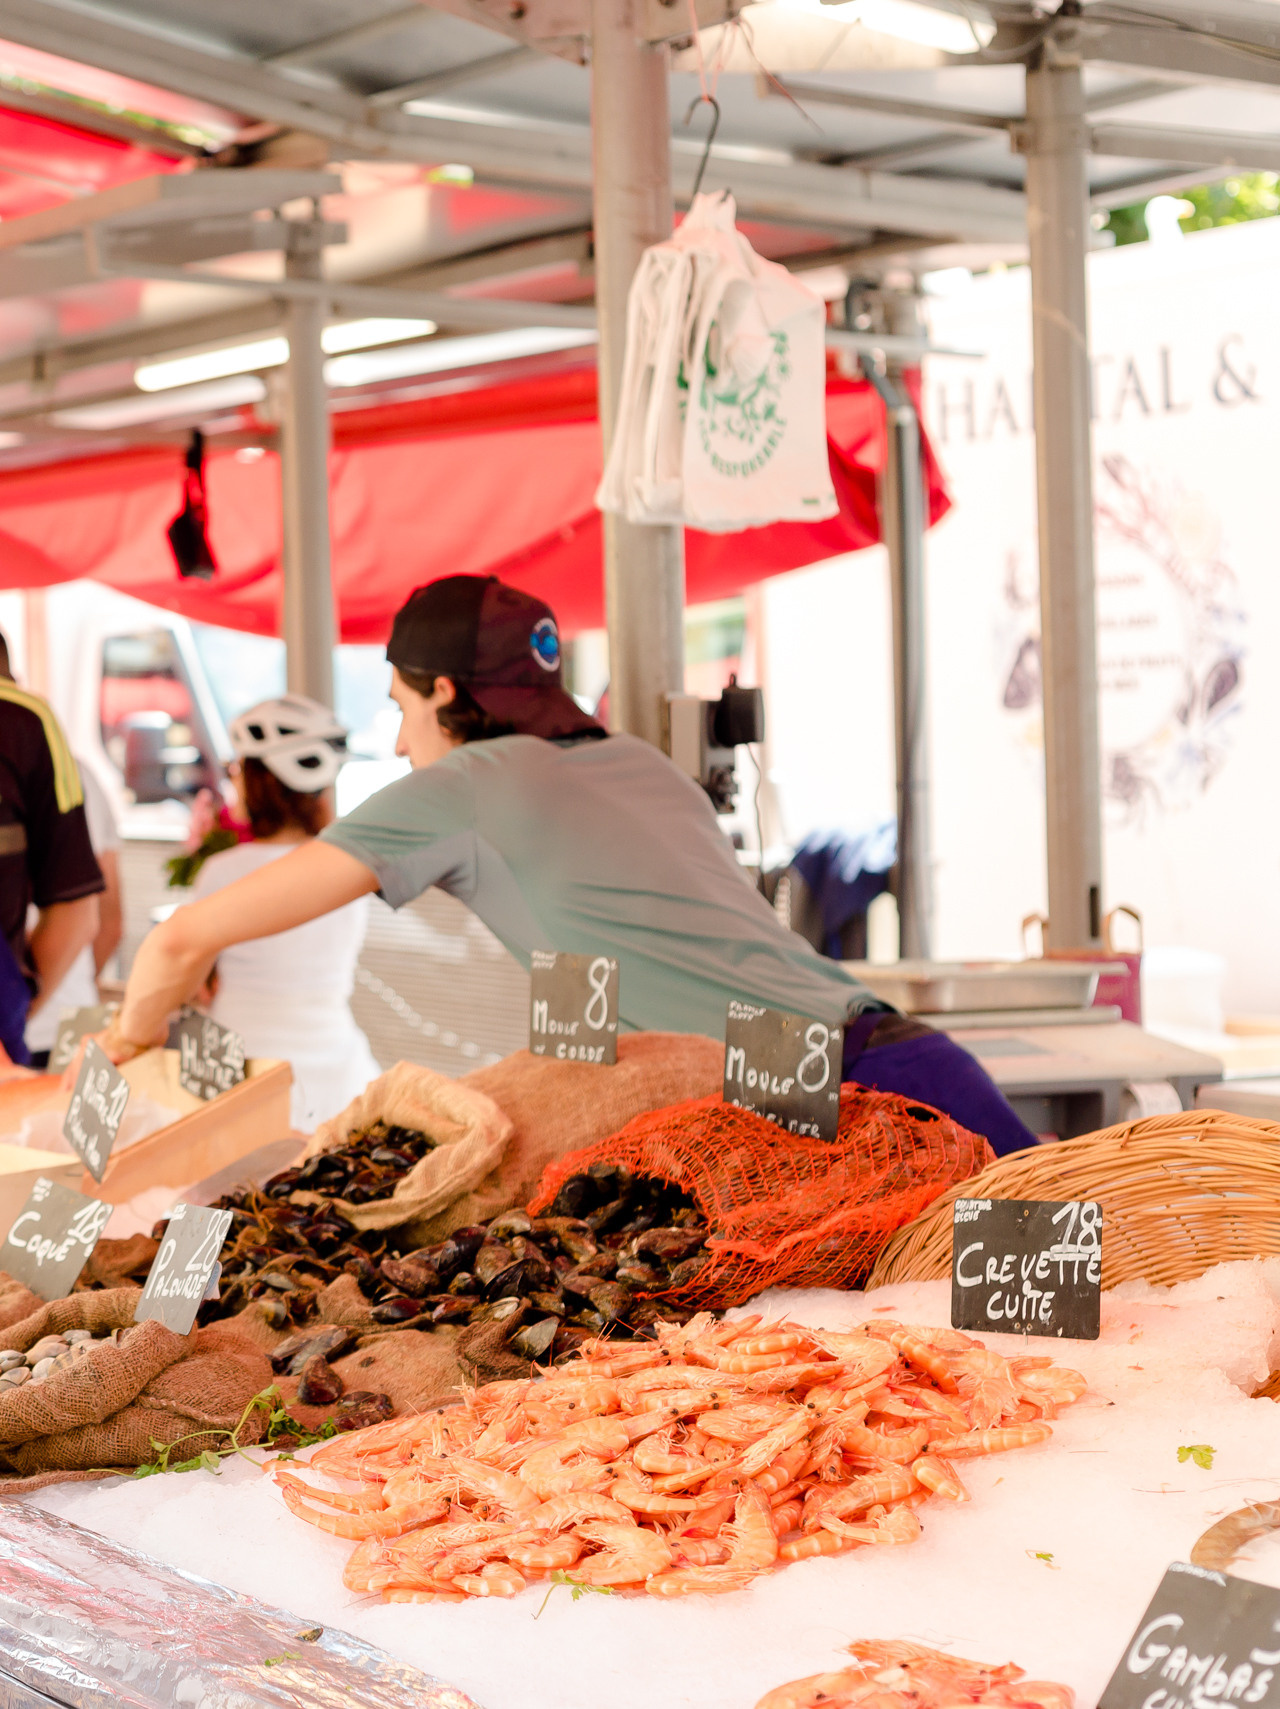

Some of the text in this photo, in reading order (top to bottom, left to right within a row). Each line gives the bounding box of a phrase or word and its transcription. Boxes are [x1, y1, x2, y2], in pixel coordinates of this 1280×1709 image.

[936, 333, 1261, 442] HATAL &
[185, 1209, 233, 1272] 28
[956, 1242, 1102, 1288] CREVETTE
